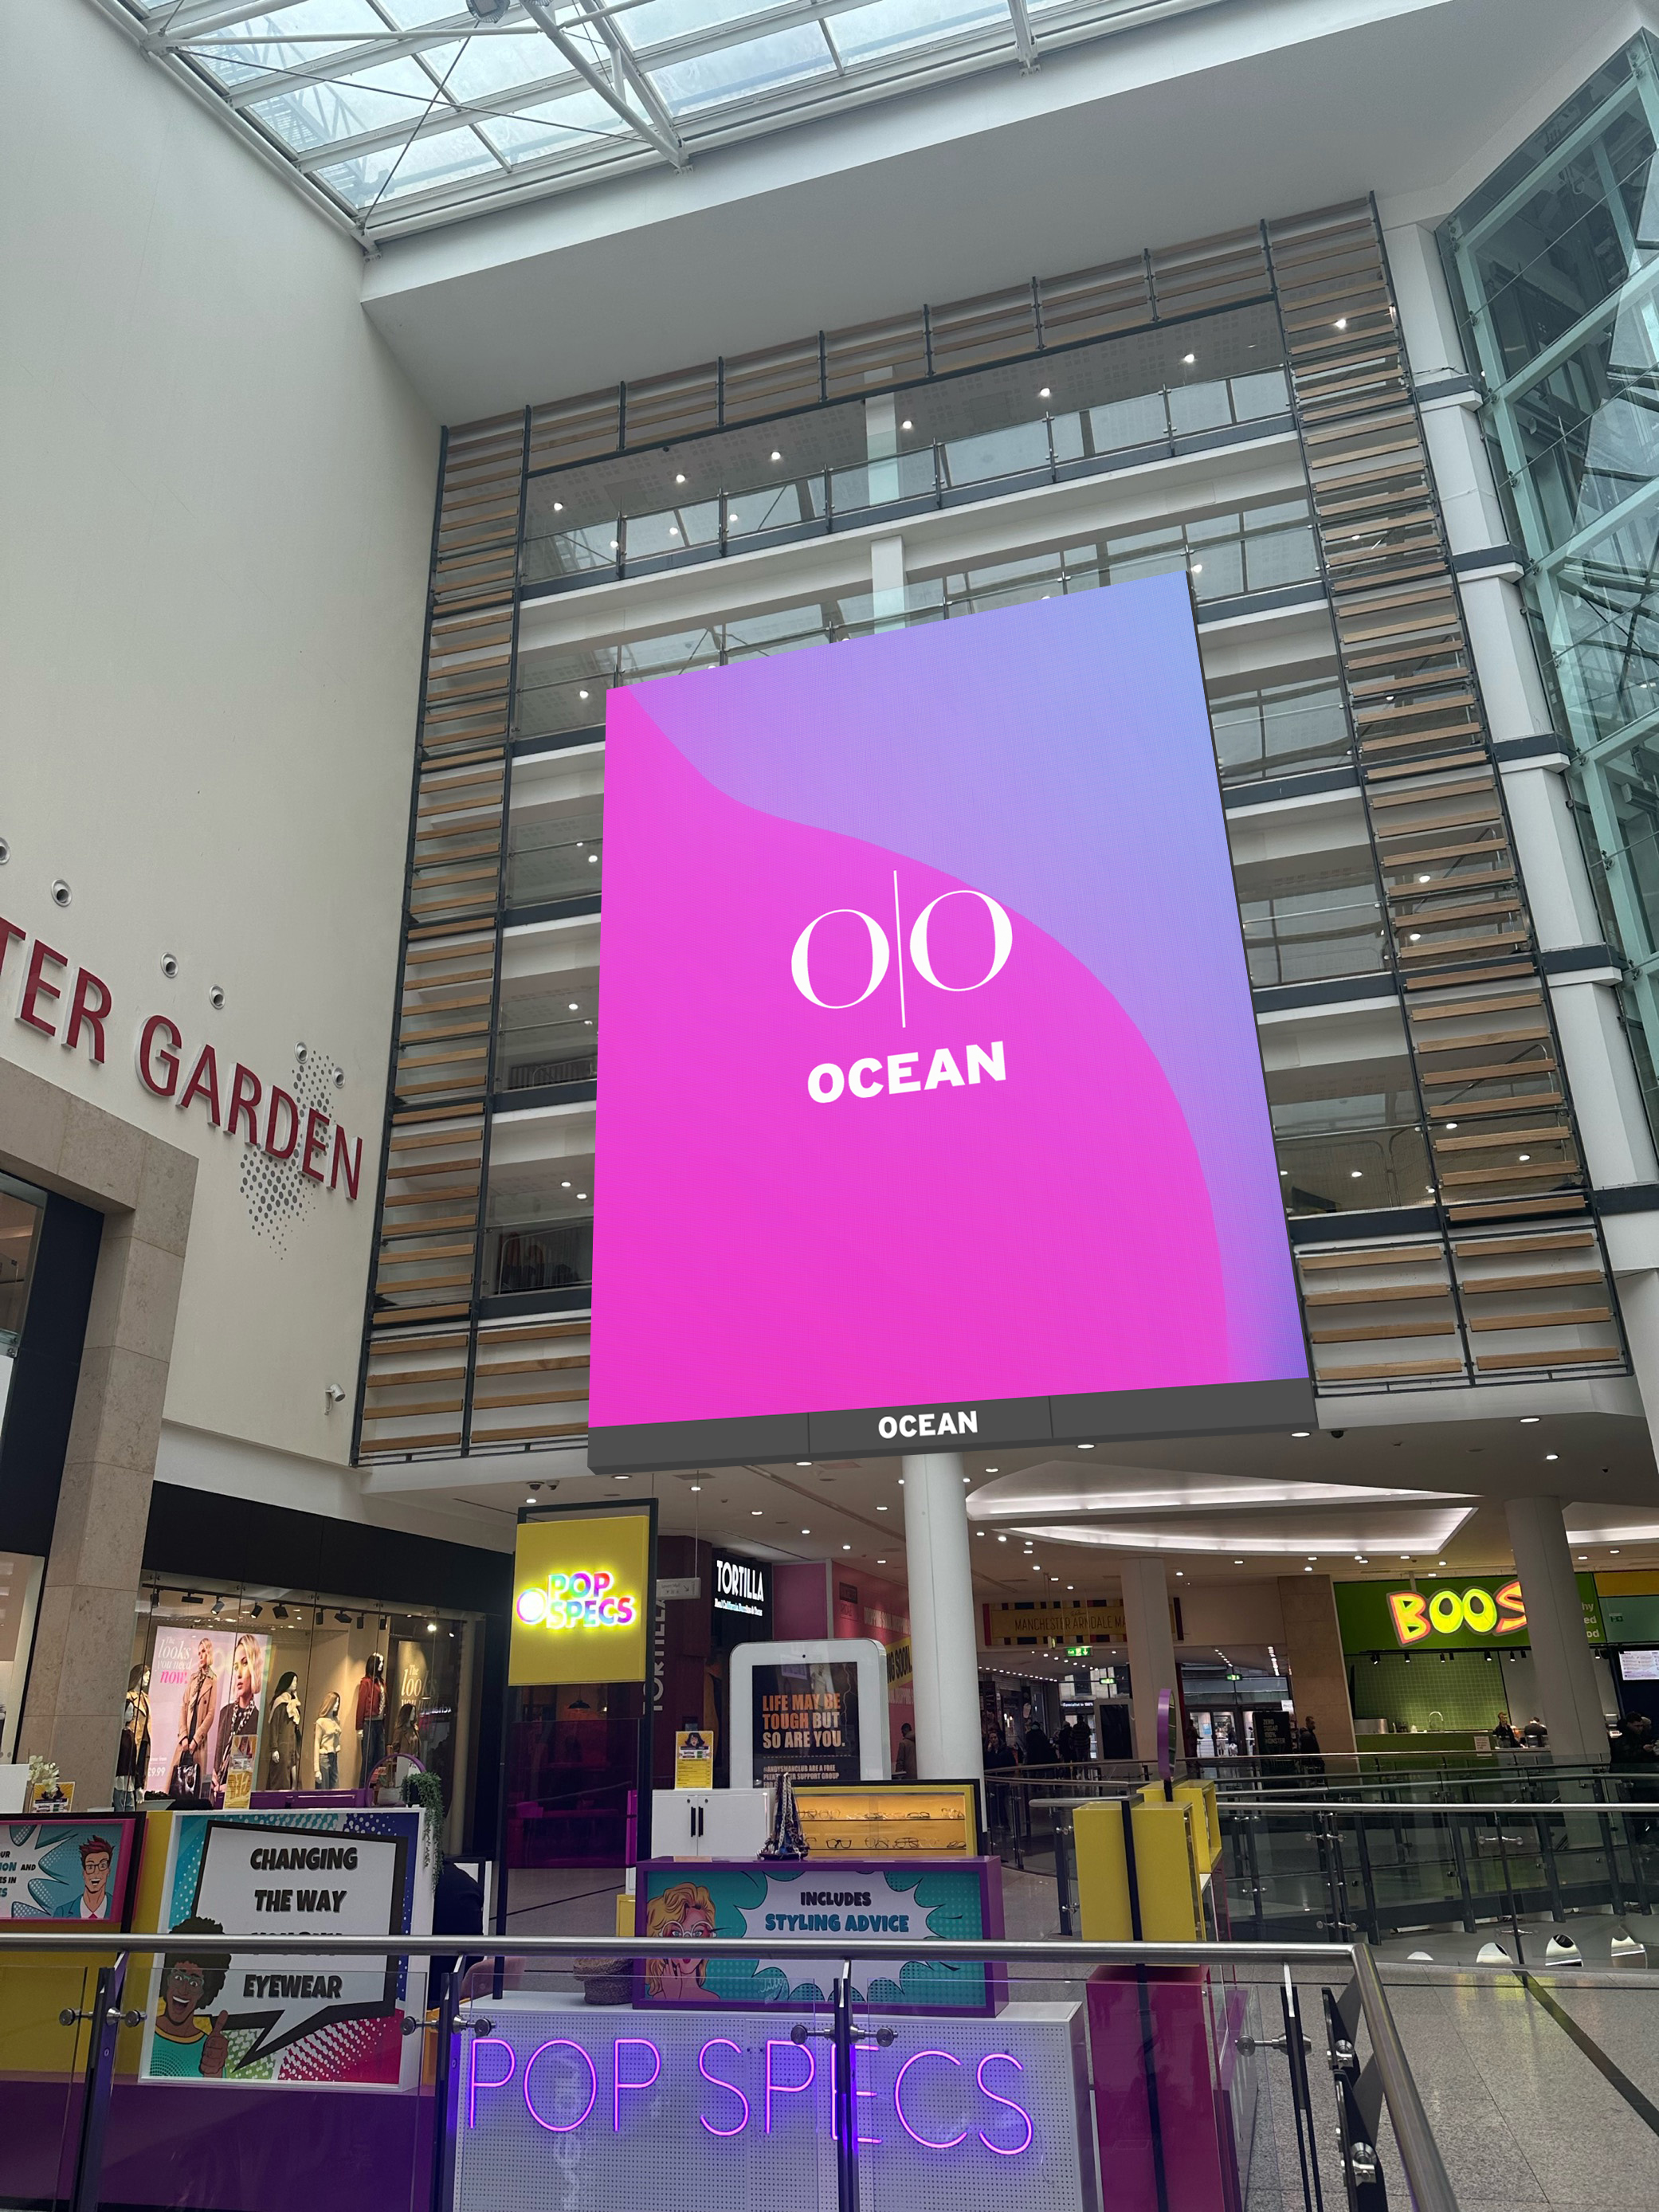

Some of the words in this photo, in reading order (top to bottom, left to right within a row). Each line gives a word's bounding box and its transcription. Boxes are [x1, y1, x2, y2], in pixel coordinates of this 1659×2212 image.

[807, 1041, 1006, 1104] OCEAN
[135, 1014, 363, 1202] GARDEN
[878, 1410, 979, 1439] OCEAN
[548, 1571, 614, 1599] POP
[717, 1560, 764, 1602] TORTILLA
[547, 1595, 636, 1628] SPECS
[1014, 1617, 1071, 1631] MANCHESTER
[1073, 1616, 1112, 1630] ARNDALE
[1390, 1581, 1528, 1645] BOOS
[159, 1639, 191, 1660] looks
[160, 1670, 188, 1684] now.
[763, 1695, 788, 1712] LIFE
[792, 1694, 820, 1711] MAY
[824, 1693, 841, 1710] BE
[763, 1712, 809, 1730] TOUGH
[813, 1712, 840, 1729] BUT
[763, 1732, 781, 1749] SO
[784, 1731, 810, 1748] ARE
[813, 1730, 845, 1747] YOU.
[250, 1847, 359, 1871] CHANGING
[254, 1889, 292, 1912] THE
[296, 1889, 347, 1912] WAY
[800, 1892, 872, 1907] INCLUDES
[765, 1913, 841, 1932] STYLING
[845, 1914, 910, 1932] ADVICE
[242, 1974, 343, 1999] EYEWEAR
[469, 2037, 661, 2134] POP
[698, 2037, 1034, 2156] SPECS
